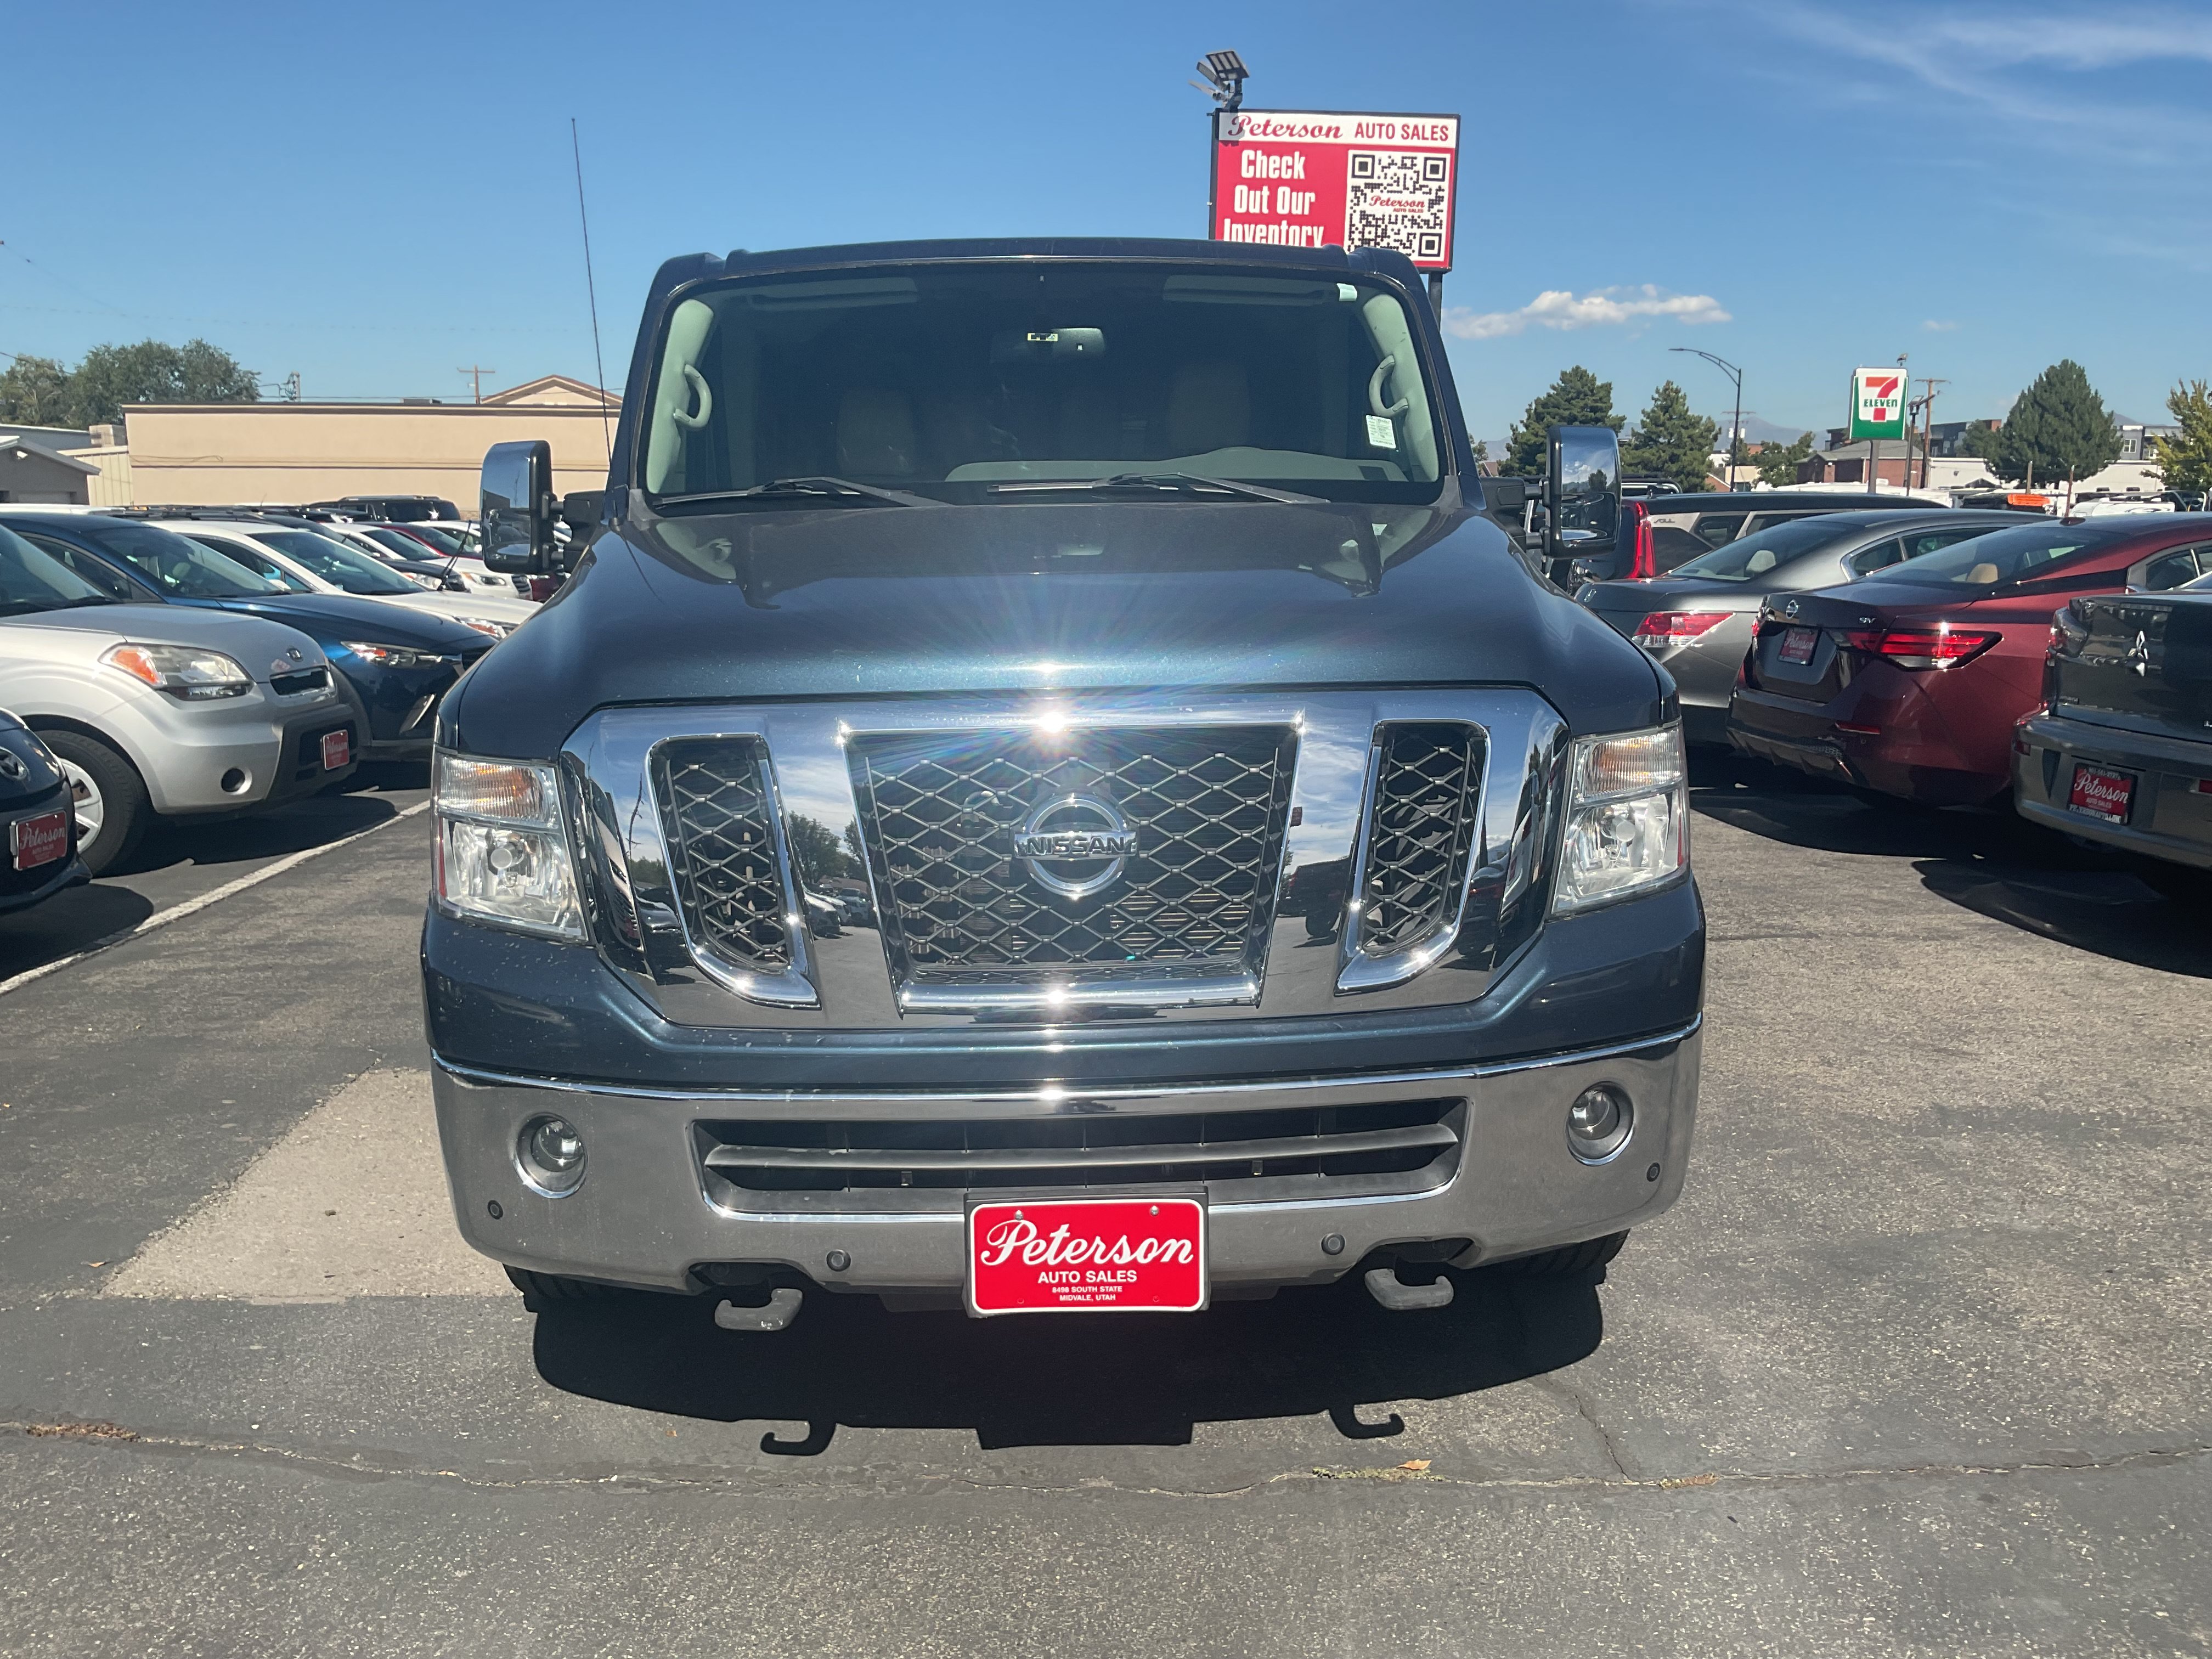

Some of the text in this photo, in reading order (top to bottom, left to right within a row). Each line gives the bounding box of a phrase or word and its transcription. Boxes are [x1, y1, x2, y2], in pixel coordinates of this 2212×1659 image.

[1228, 115, 1448, 142] Peterson AUTO SALES
[1241, 150, 1306, 179] Check
[1234, 185, 1316, 215] Out Our
[1369, 195, 1425, 208] Peterson
[1223, 218, 1324, 248] Inventory
[1866, 376, 1898, 421] 7
[2074, 772, 2129, 804] Peterson
[20, 827, 65, 850] Peterson
[1026, 836, 1124, 857] NISSAN
[981, 1219, 1194, 1266] Peterson
[1038, 1270, 1138, 1284] AUTO SALES
